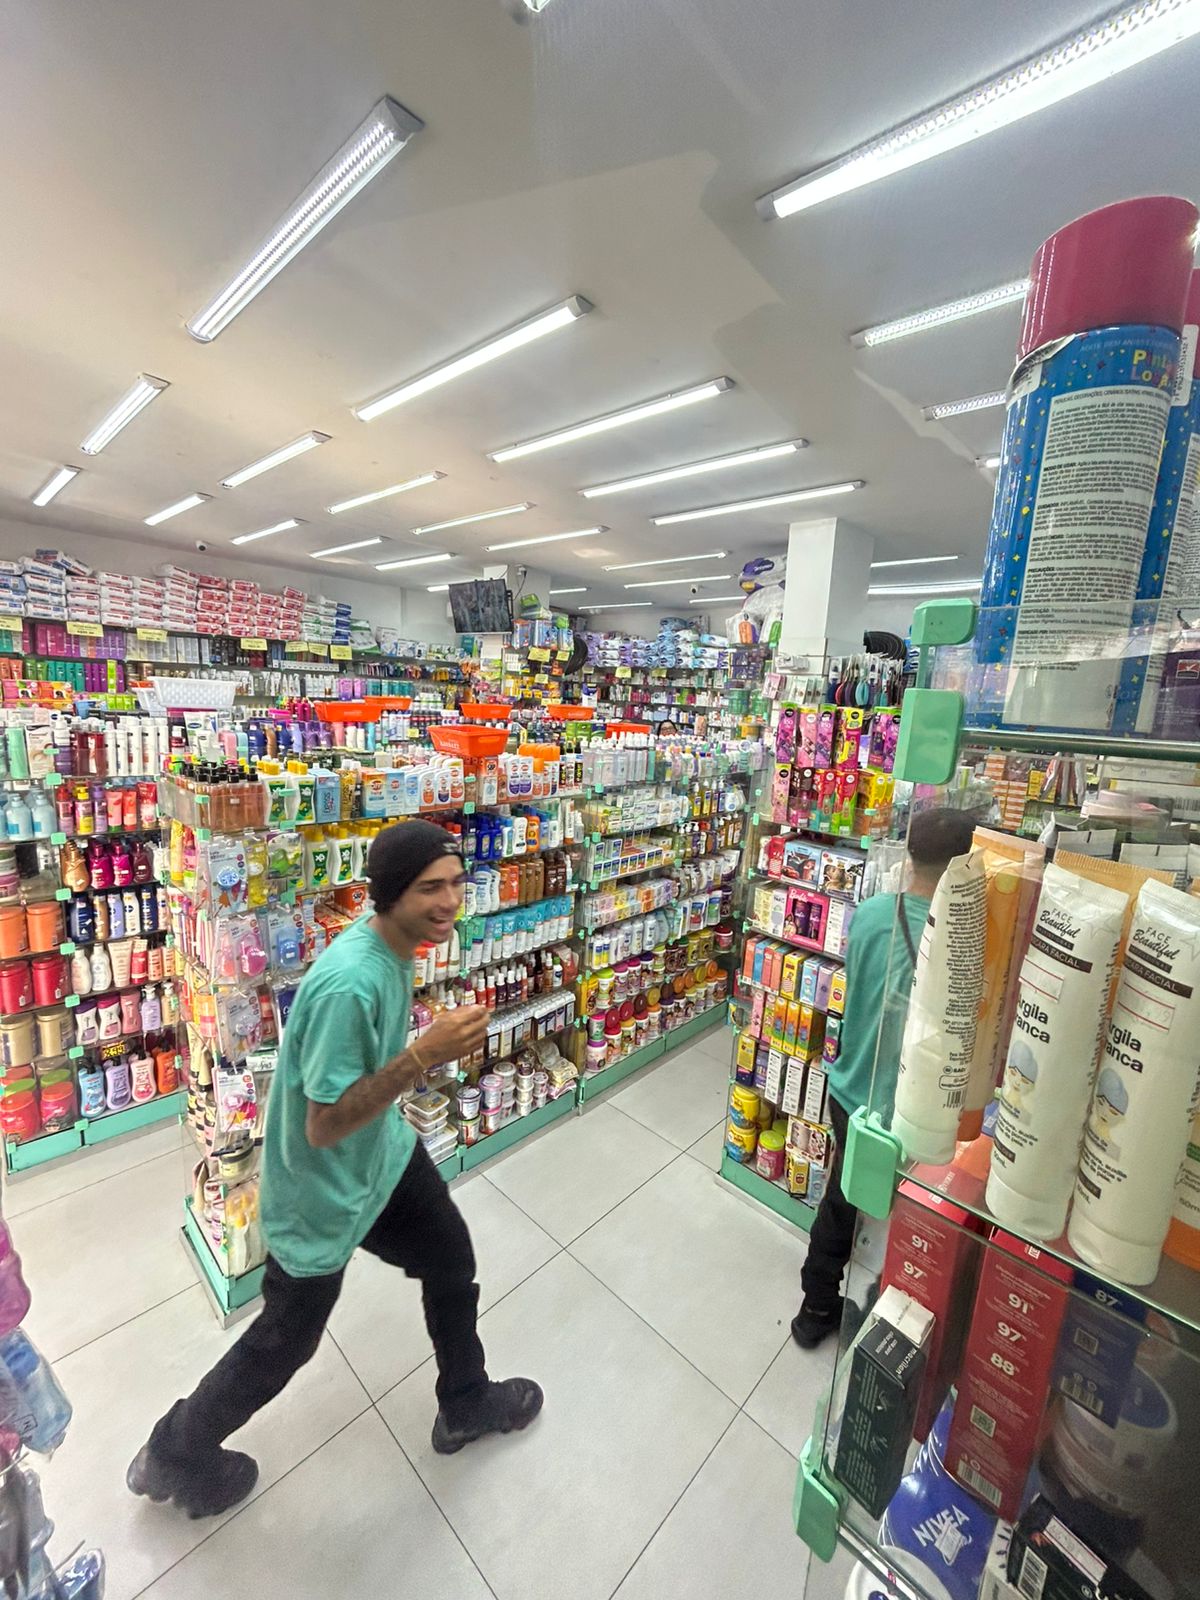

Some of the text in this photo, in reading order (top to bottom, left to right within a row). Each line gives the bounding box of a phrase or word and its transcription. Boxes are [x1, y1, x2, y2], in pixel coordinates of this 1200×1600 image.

[1040, 910, 1081, 938] Beautiful
[1051, 908, 1073, 924] FACE
[1133, 929, 1180, 960] Beautiful
[1146, 927, 1171, 944] FACE
[1050, 947, 1080, 968] FACIAL
[1144, 970, 1178, 993] FACIAL
[896, 1347, 917, 1375] macrilan
[912, 1504, 970, 1547] NIVEA
